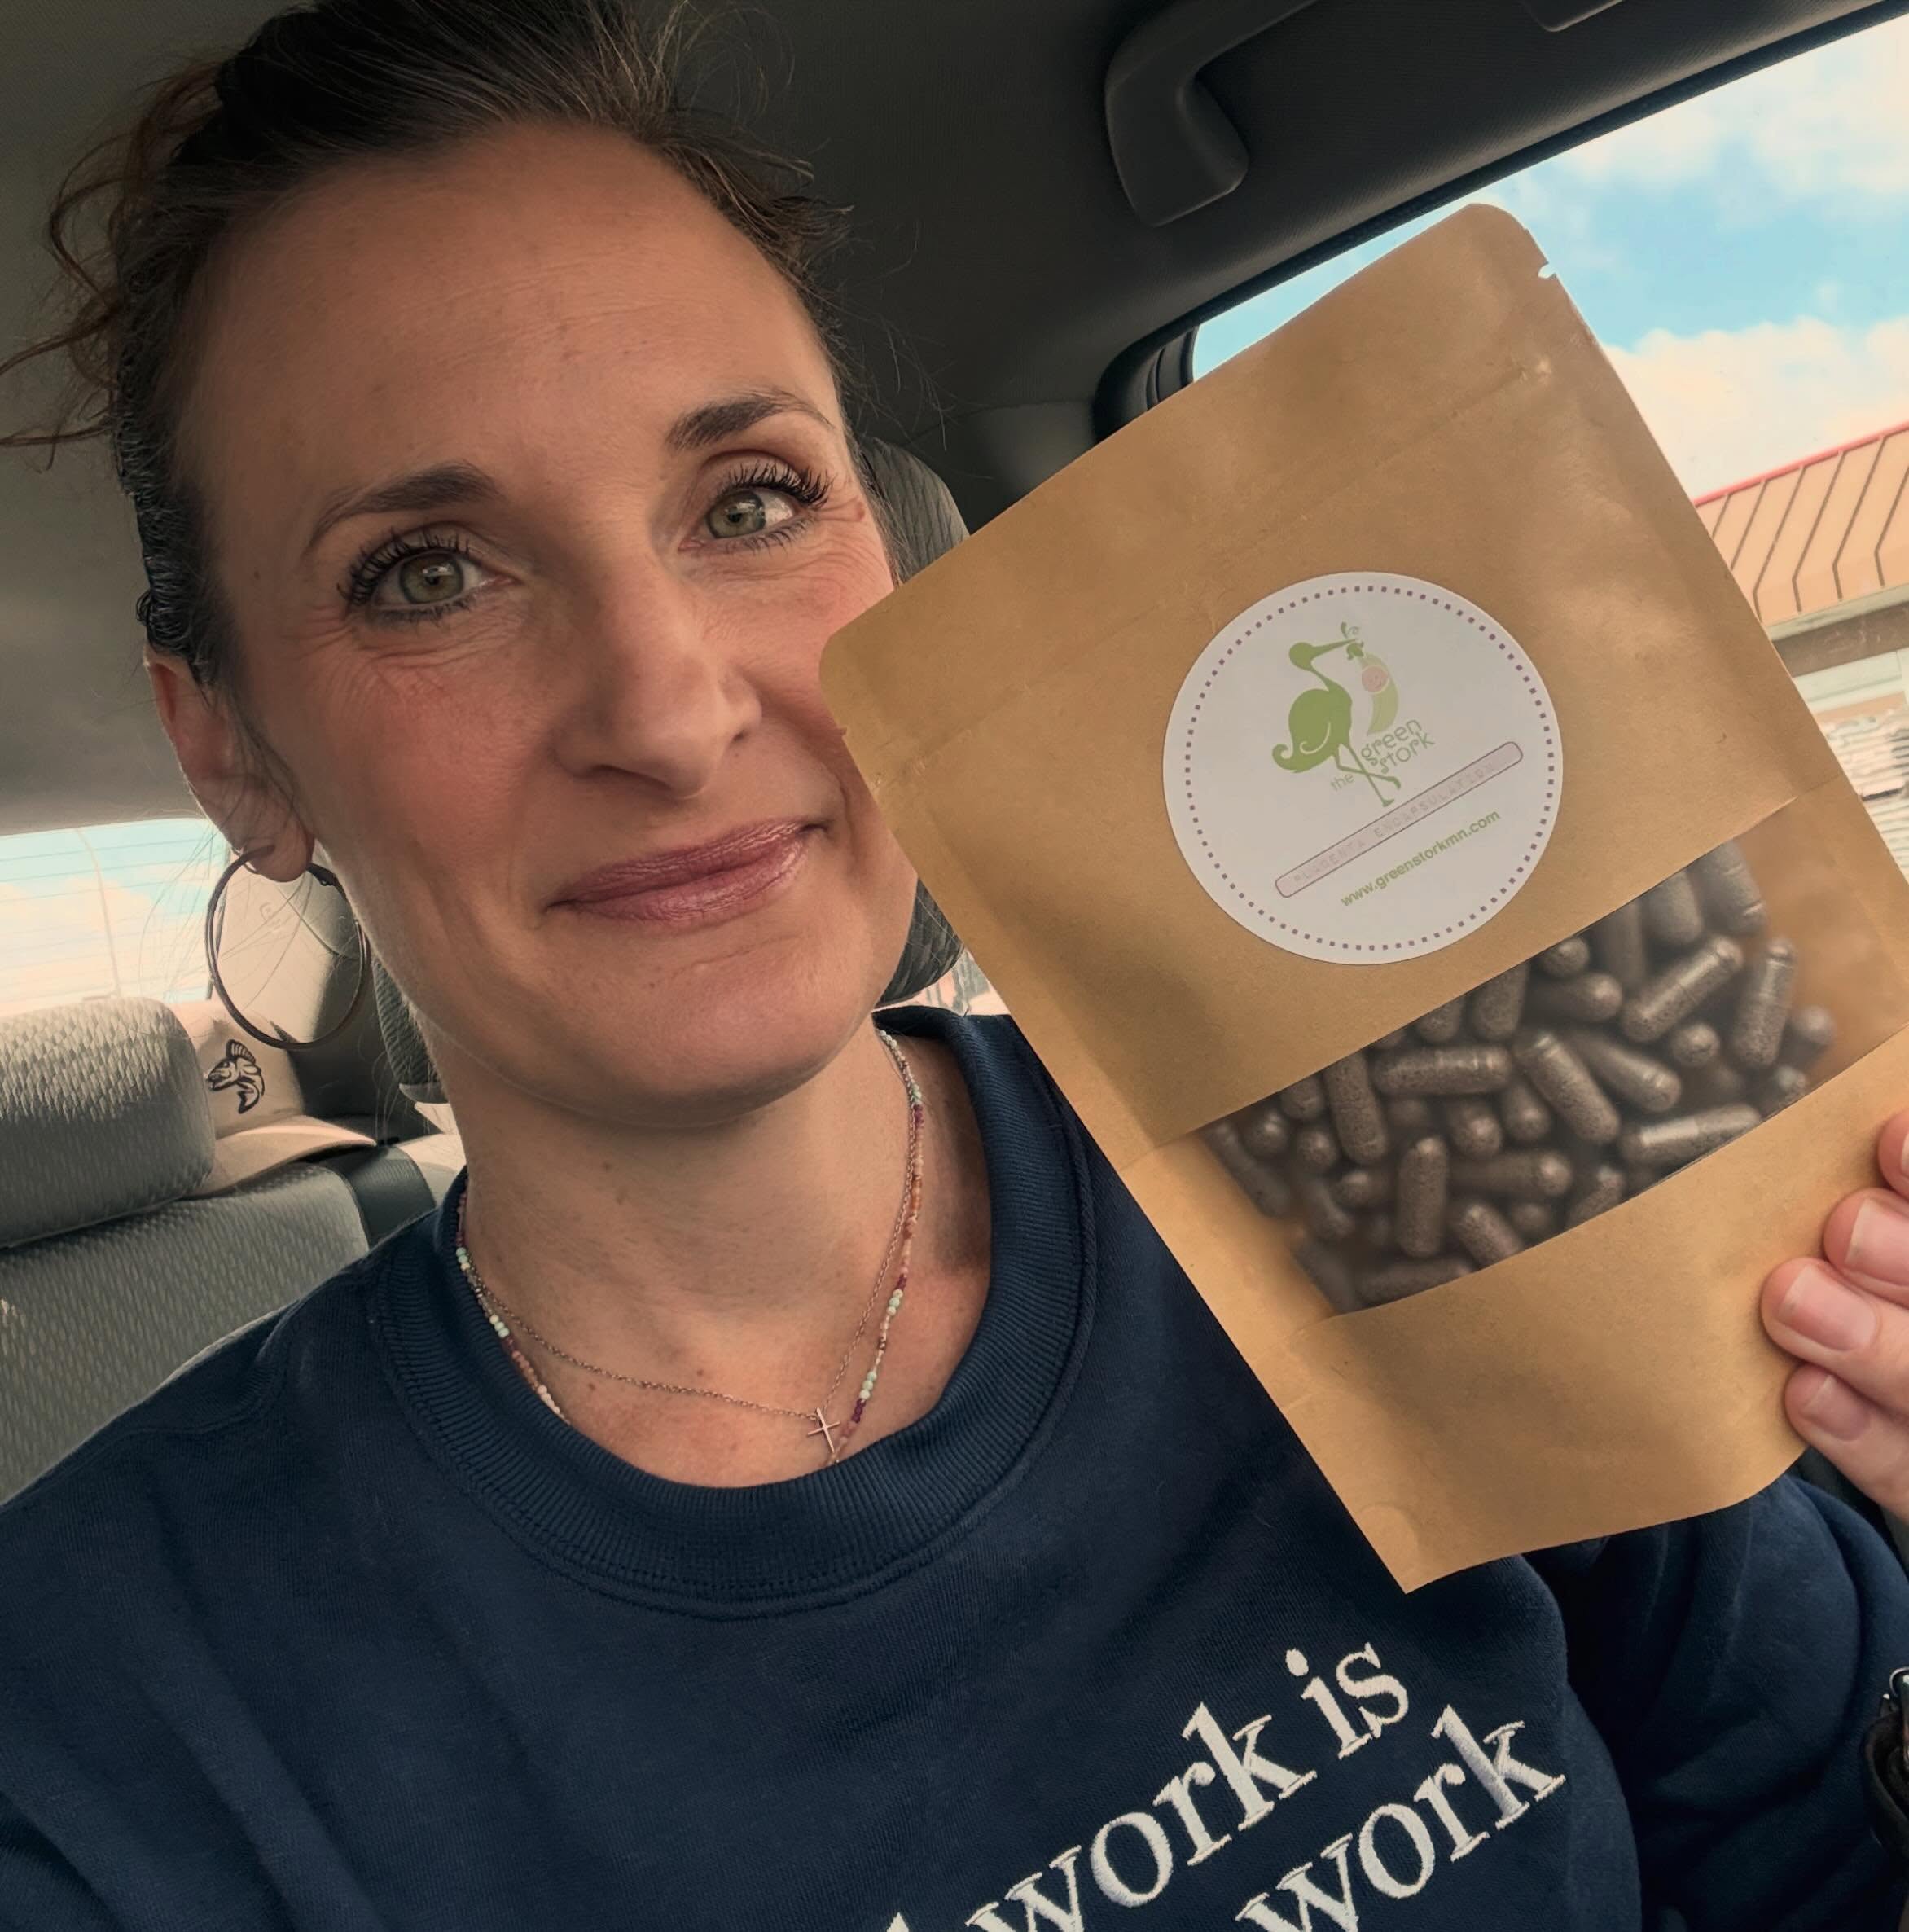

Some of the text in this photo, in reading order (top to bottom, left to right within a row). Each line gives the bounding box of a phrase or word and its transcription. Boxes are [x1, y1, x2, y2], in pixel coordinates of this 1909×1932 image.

[1361, 719, 1422, 766] green
[1378, 731, 1436, 775] stork
[1331, 772, 1354, 793] the
[1341, 809, 1501, 907] www.greenstorkmn.com
[967, 1642, 1410, 1932] work is
[1235, 1704, 1566, 1932] work
